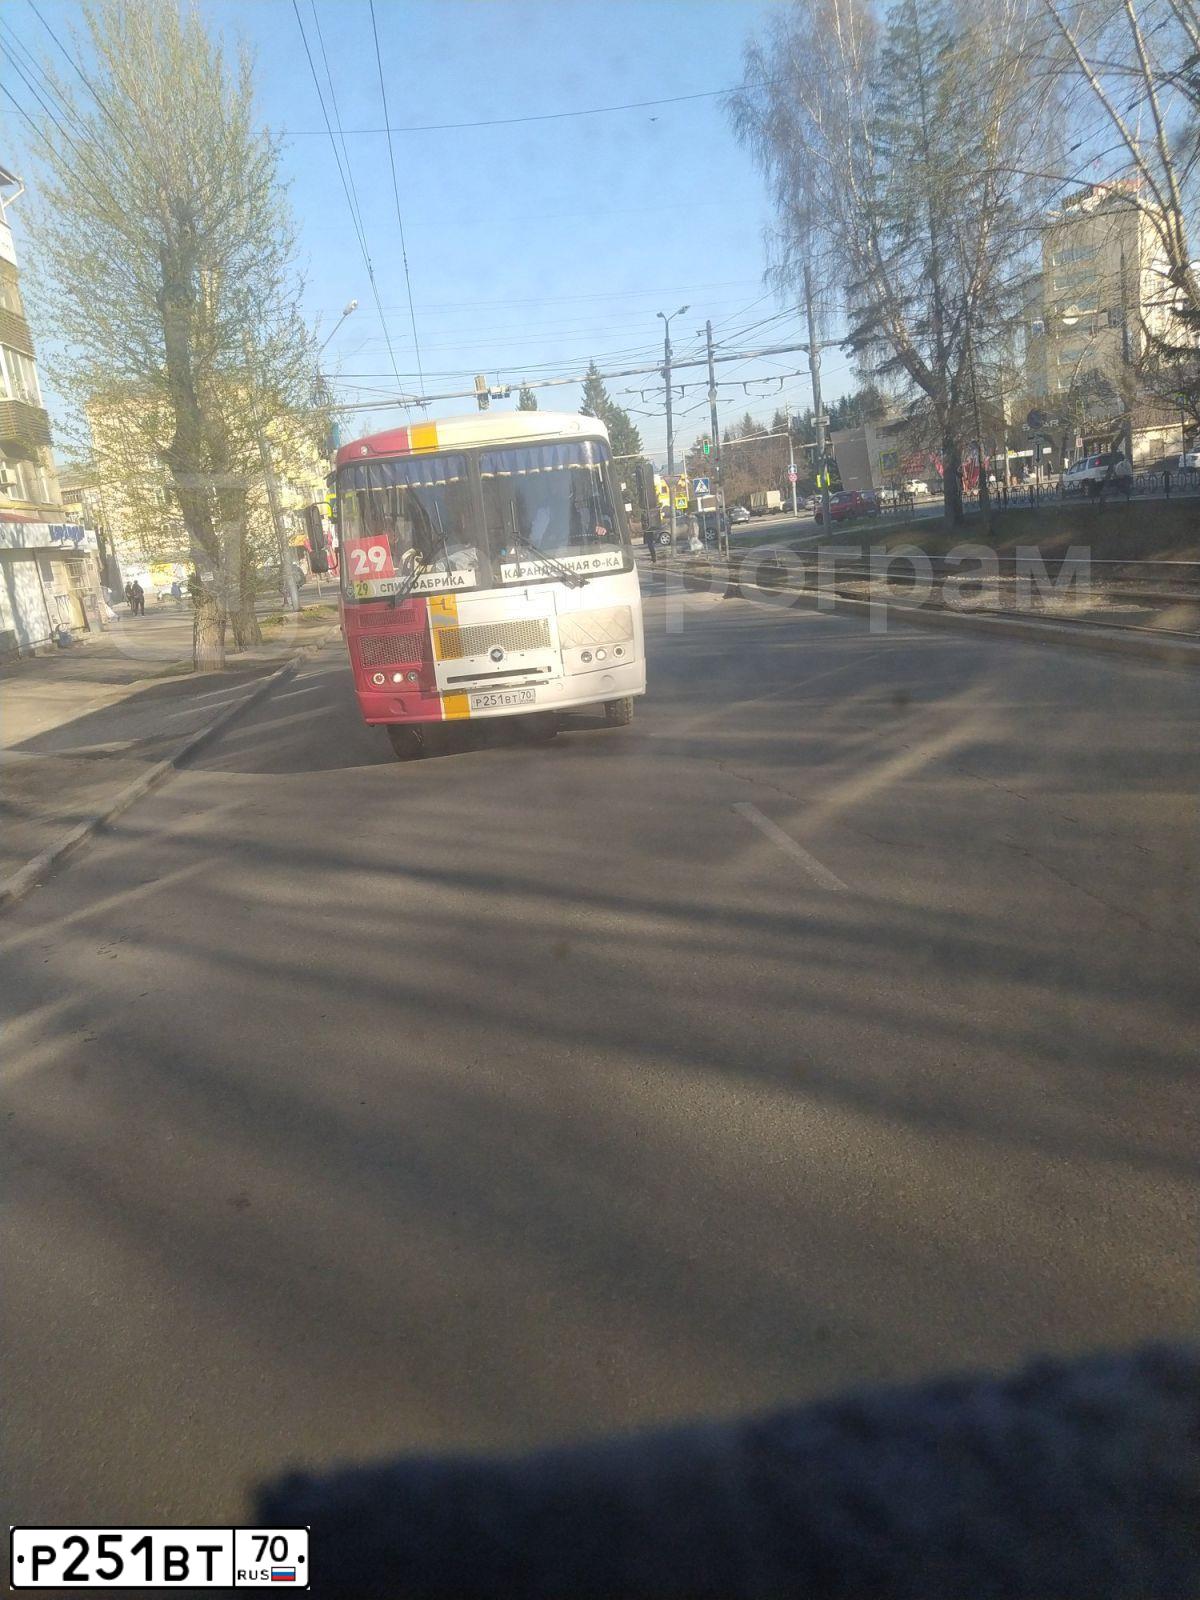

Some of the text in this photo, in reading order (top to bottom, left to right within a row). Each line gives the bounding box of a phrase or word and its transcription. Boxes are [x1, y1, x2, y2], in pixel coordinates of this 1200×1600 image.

[351, 546, 387, 575] 29
[504, 556, 620, 579] КАРАНДНАЯ Ф-КА
[356, 582, 369, 596] 29
[380, 576, 465, 593] СПИФАБРИКА
[475, 694, 518, 707] Р251ВТ
[520, 690, 532, 699] 70
